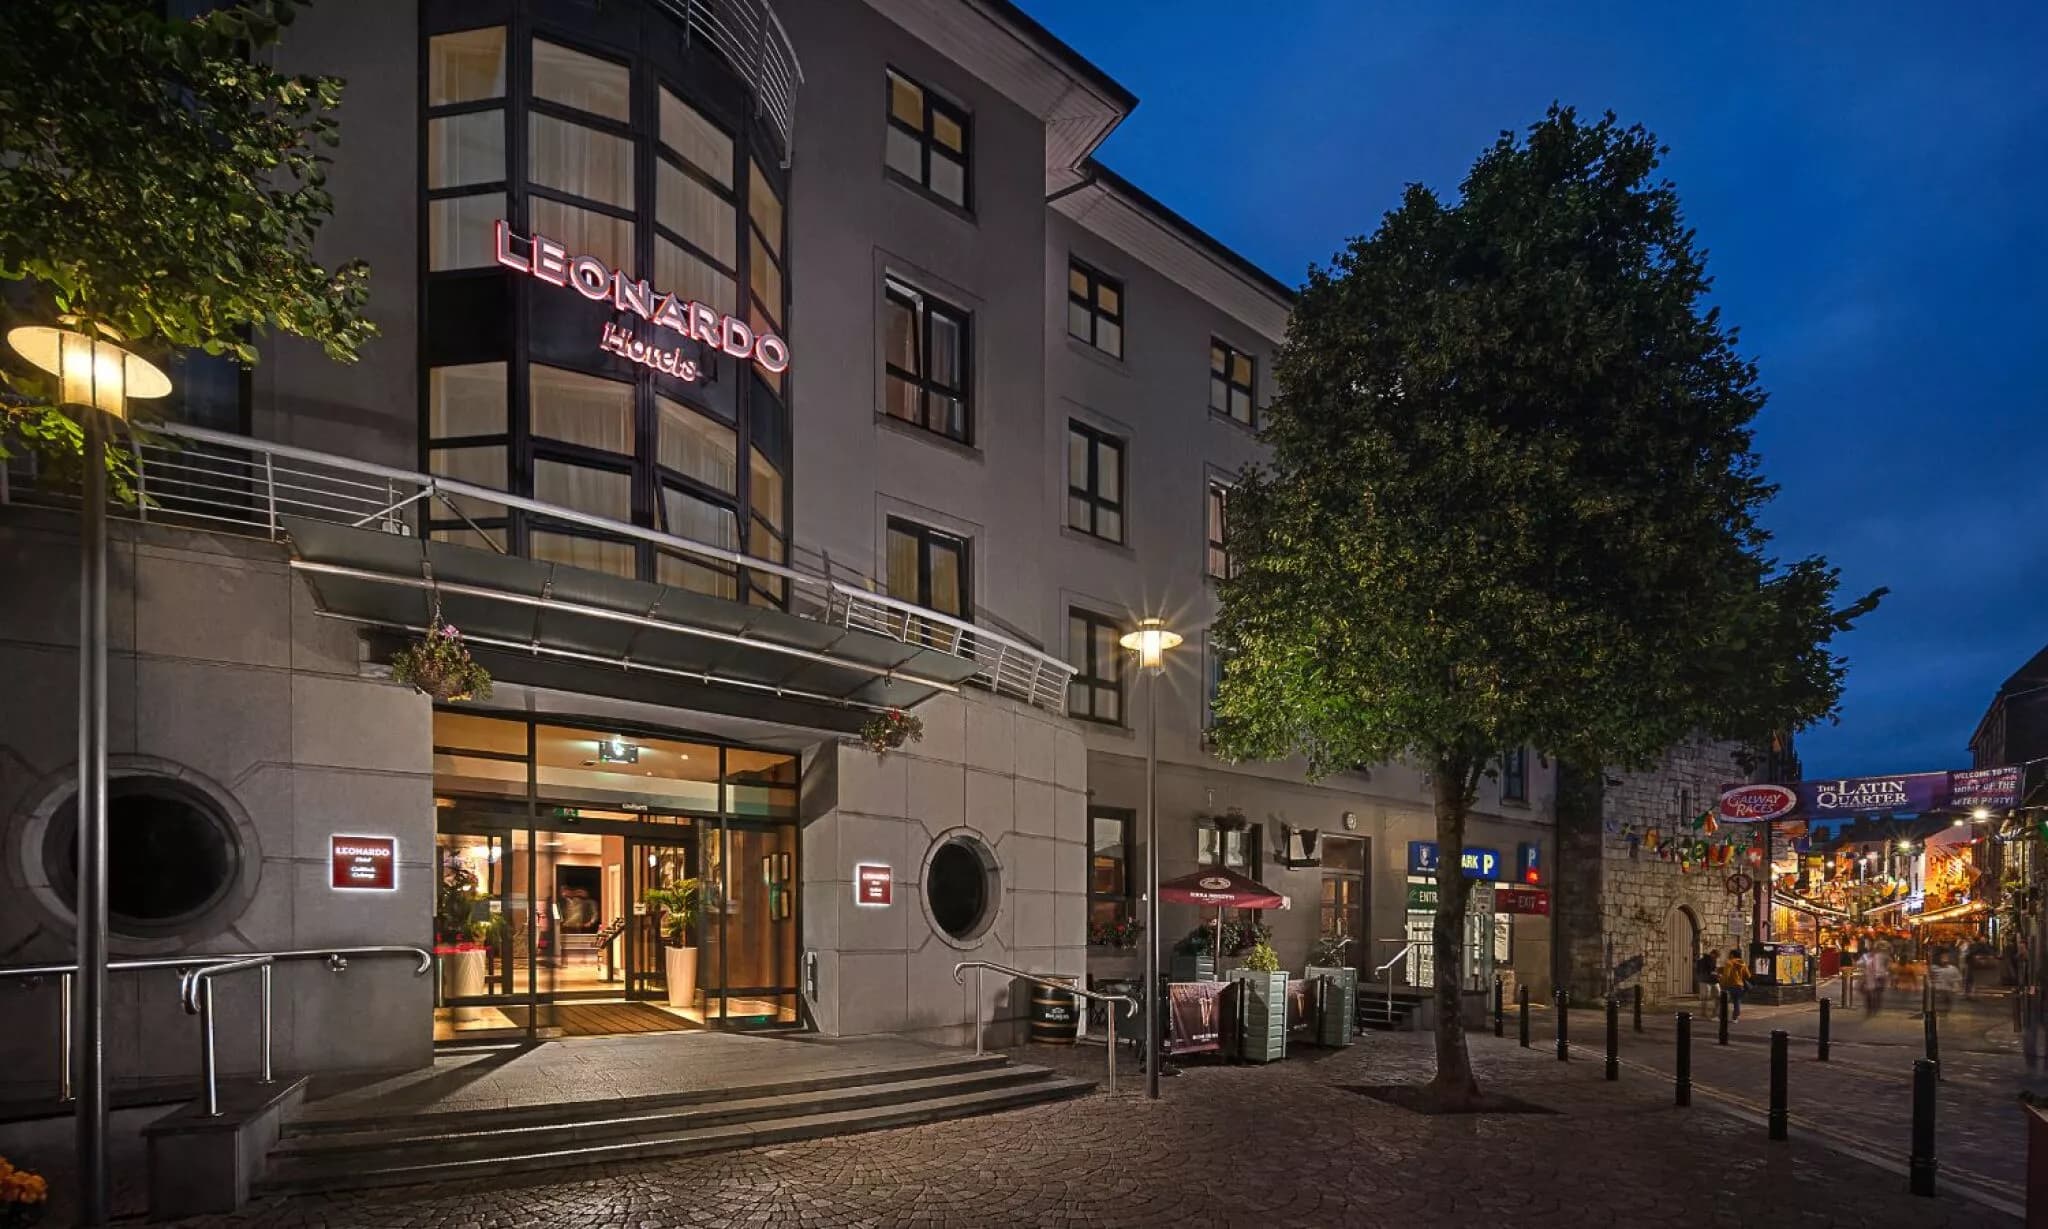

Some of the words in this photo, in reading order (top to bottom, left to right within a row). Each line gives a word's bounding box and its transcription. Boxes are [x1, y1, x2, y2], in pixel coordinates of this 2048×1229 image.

[495, 219, 790, 373] LEONARDO
[600, 321, 698, 382] Hotels
[1953, 769, 1990, 780] WELCOME
[1816, 785, 1836, 793] THE
[1838, 780, 1906, 796] LATIN
[1727, 794, 1781, 808] GALWAY
[1816, 792, 1908, 809] QUARTER
[1736, 803, 1775, 816] RACES
[335, 846, 390, 856] LEONARDO
[1483, 854, 1495, 875] P
